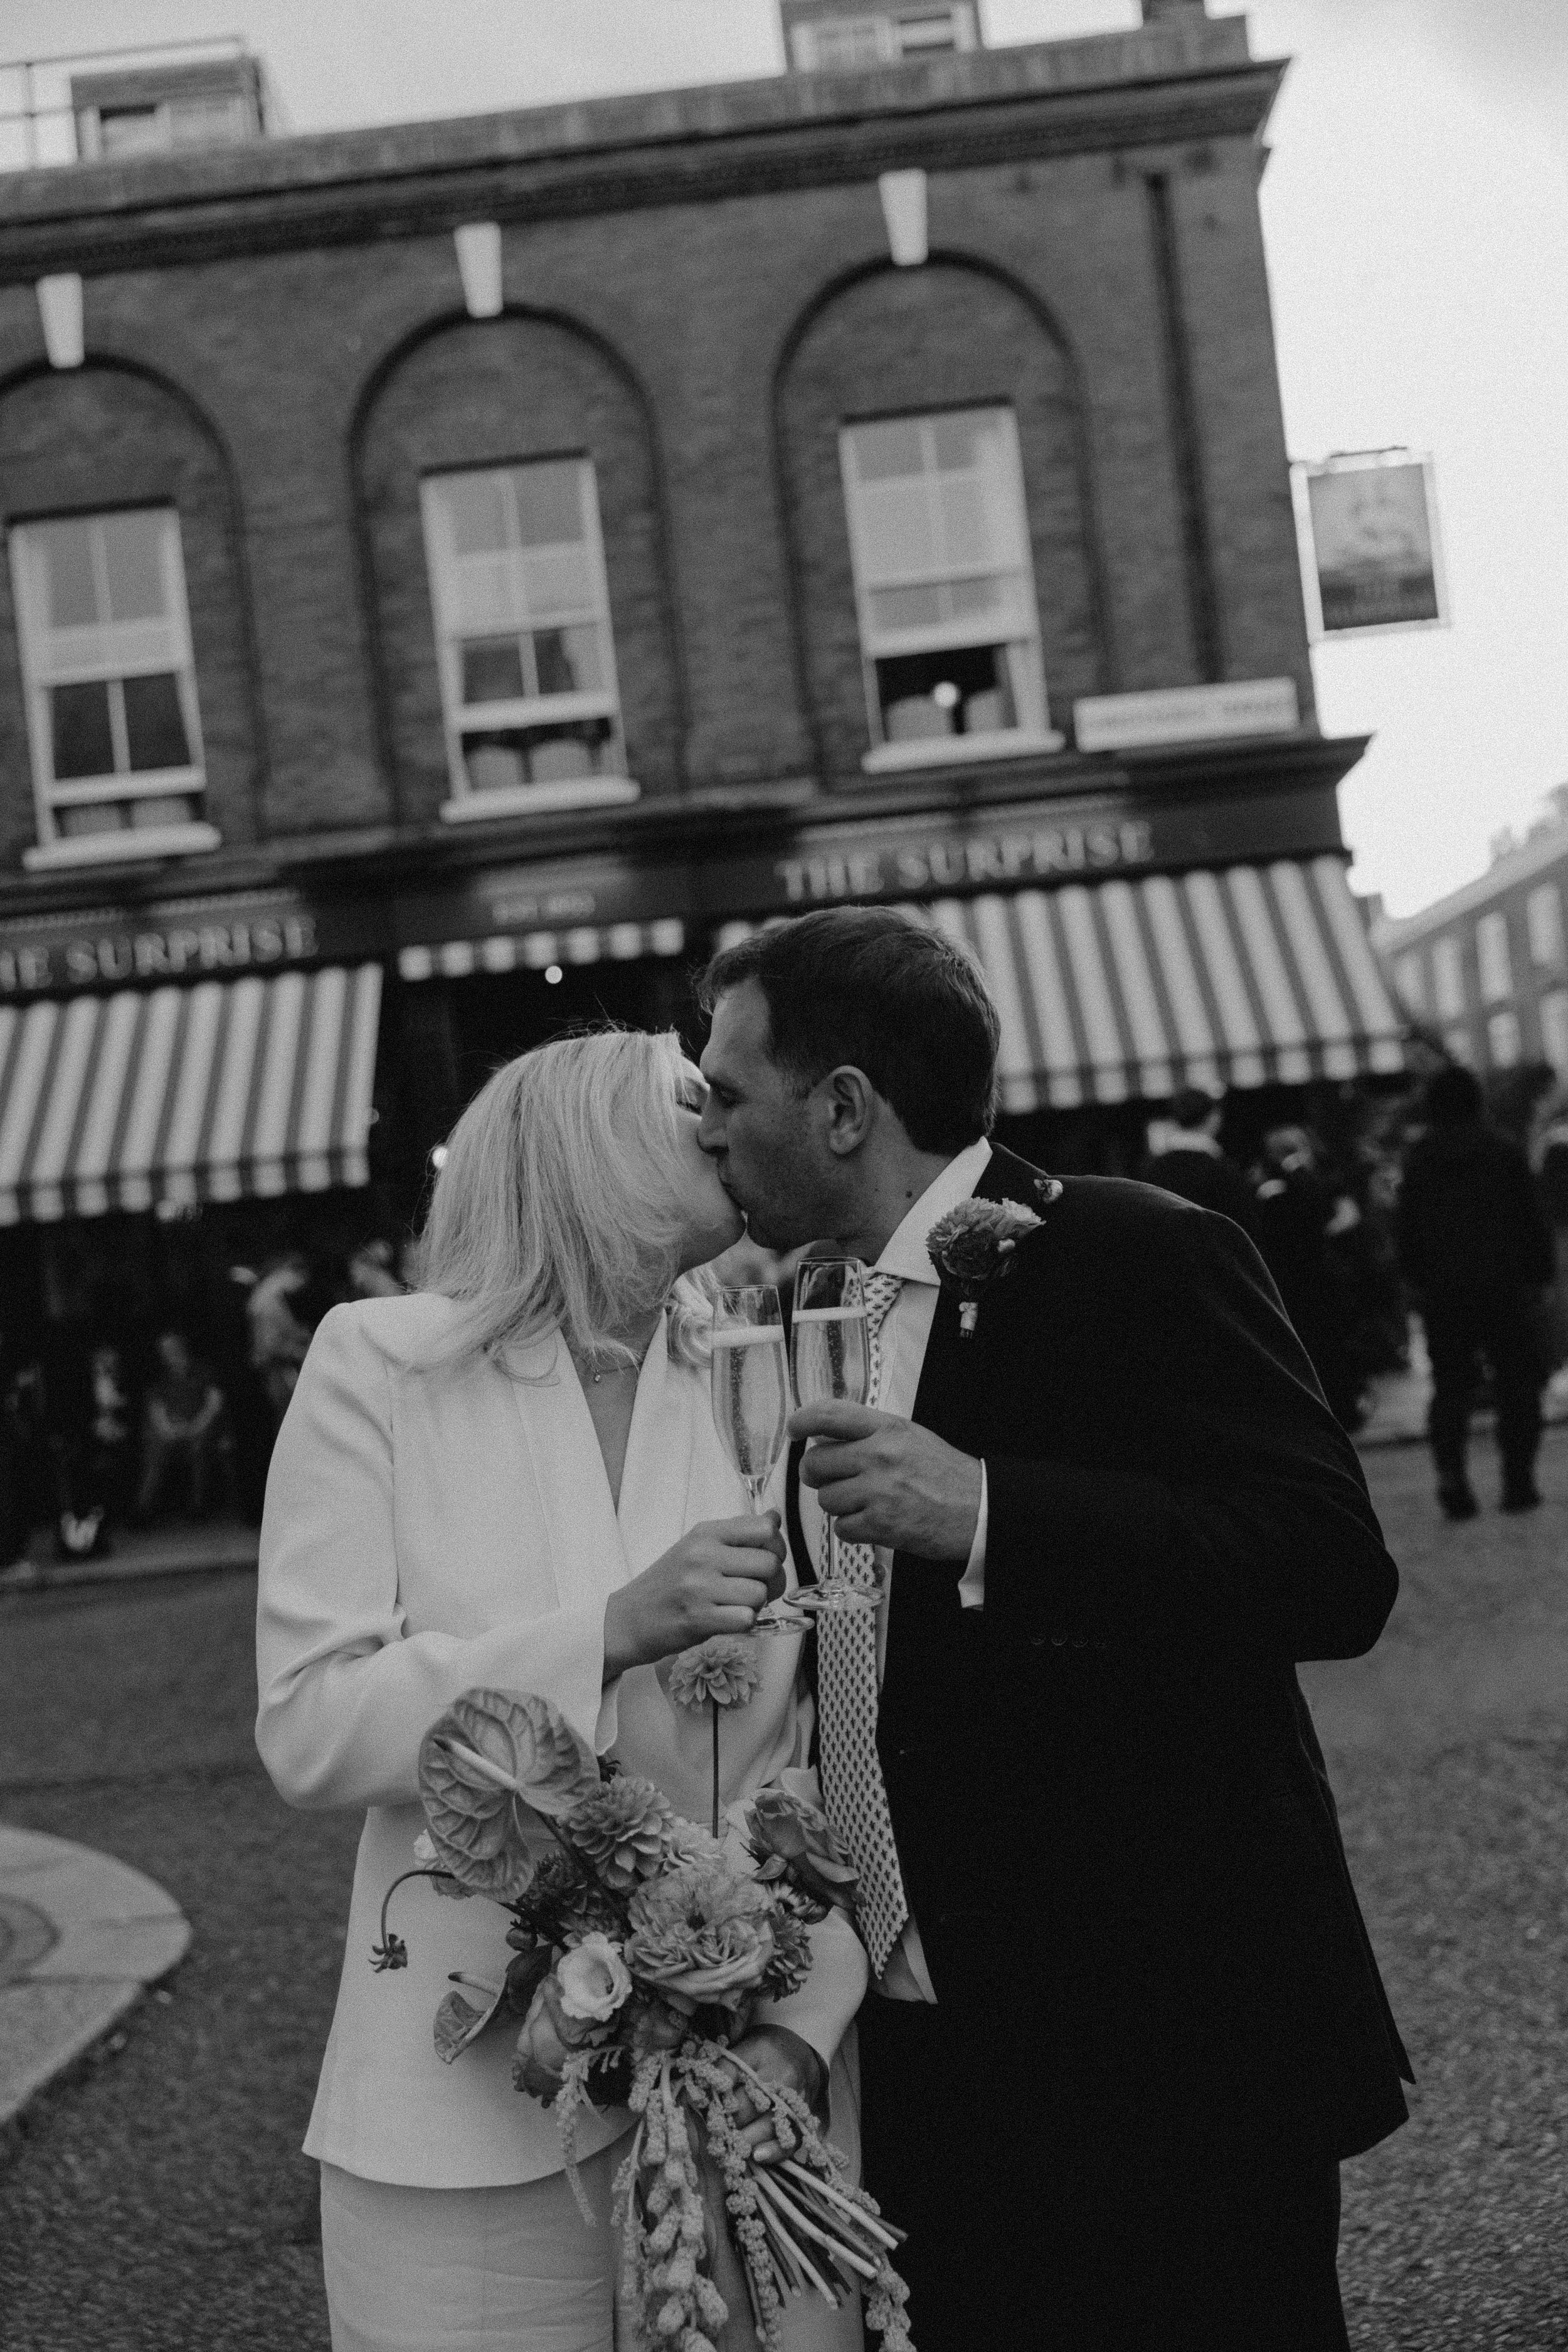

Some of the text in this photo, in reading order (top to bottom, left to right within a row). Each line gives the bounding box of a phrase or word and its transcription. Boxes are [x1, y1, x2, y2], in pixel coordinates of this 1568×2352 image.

[774, 820, 1154, 901] THE SURPRISE
[66, 914, 319, 984] SURPRISE
